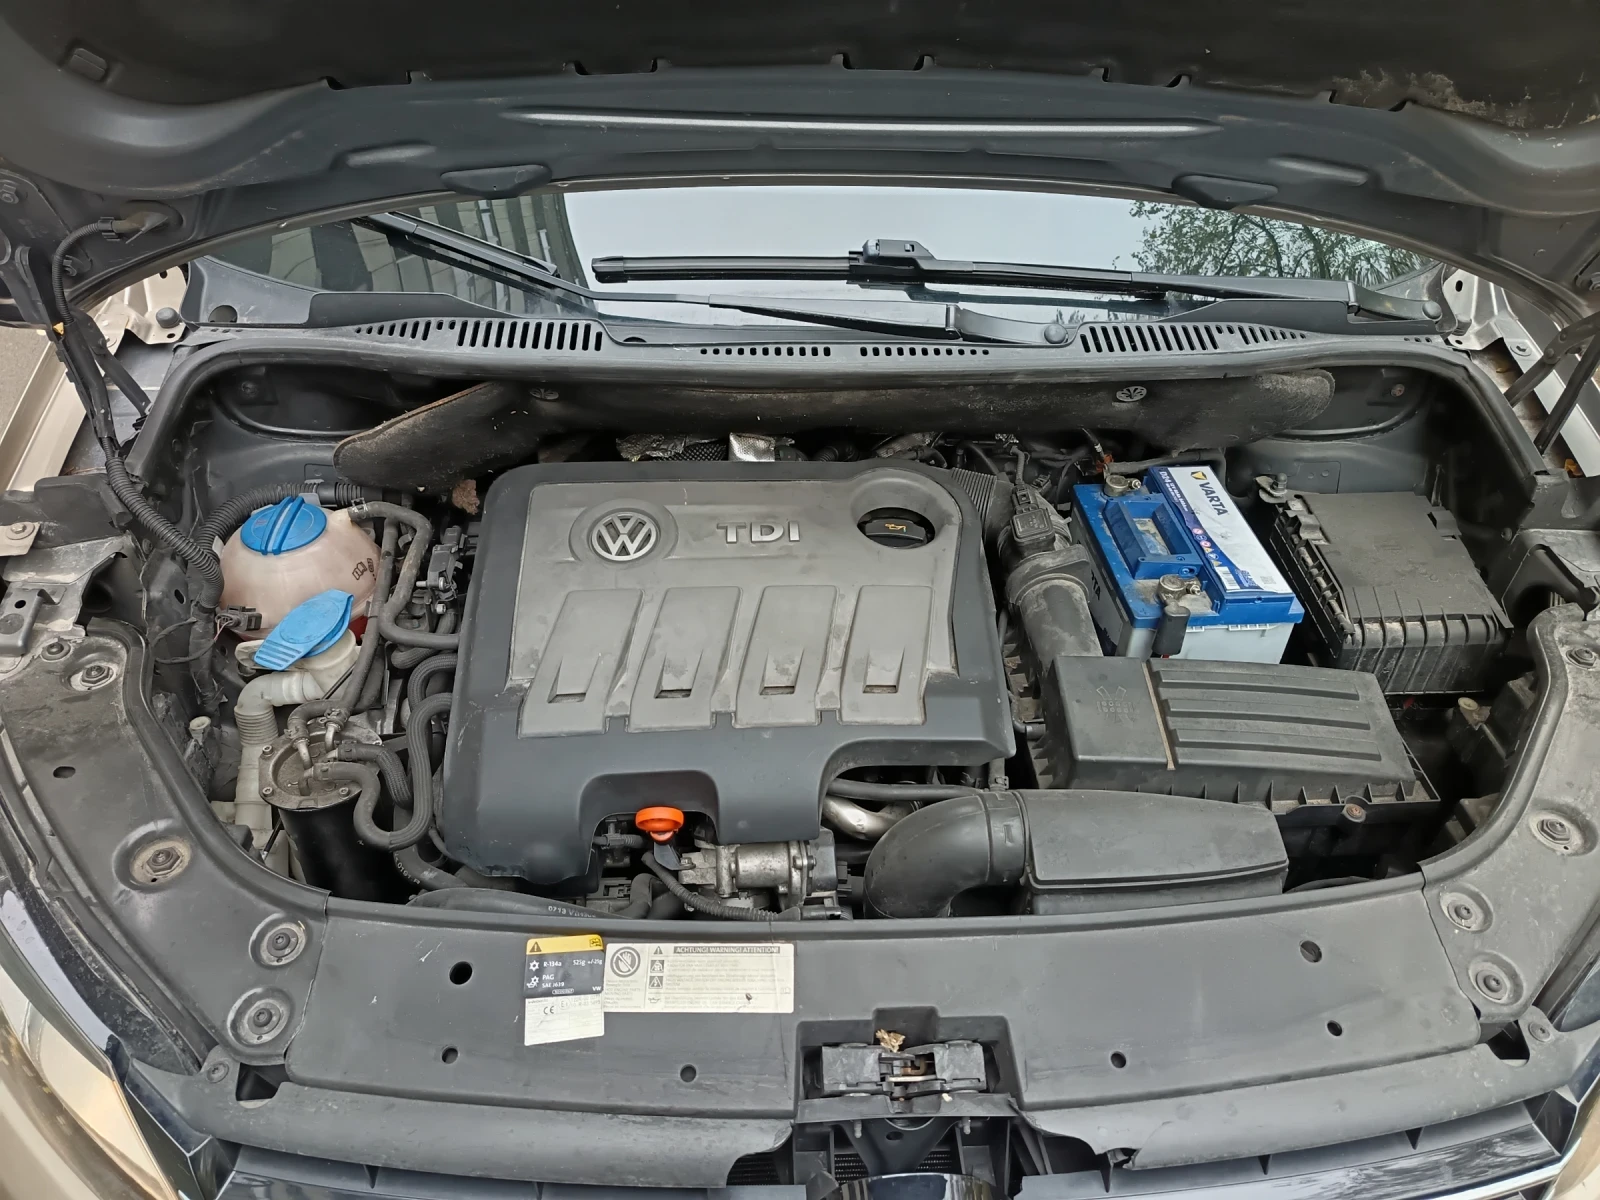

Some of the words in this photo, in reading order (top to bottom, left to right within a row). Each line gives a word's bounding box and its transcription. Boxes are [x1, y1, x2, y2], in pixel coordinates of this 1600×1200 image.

[1199, 482, 1228, 516] VARTA
[716, 521, 801, 544] TDI
[742, 946, 779, 954] ATTENTION!
[543, 960, 562, 968] R-134a
